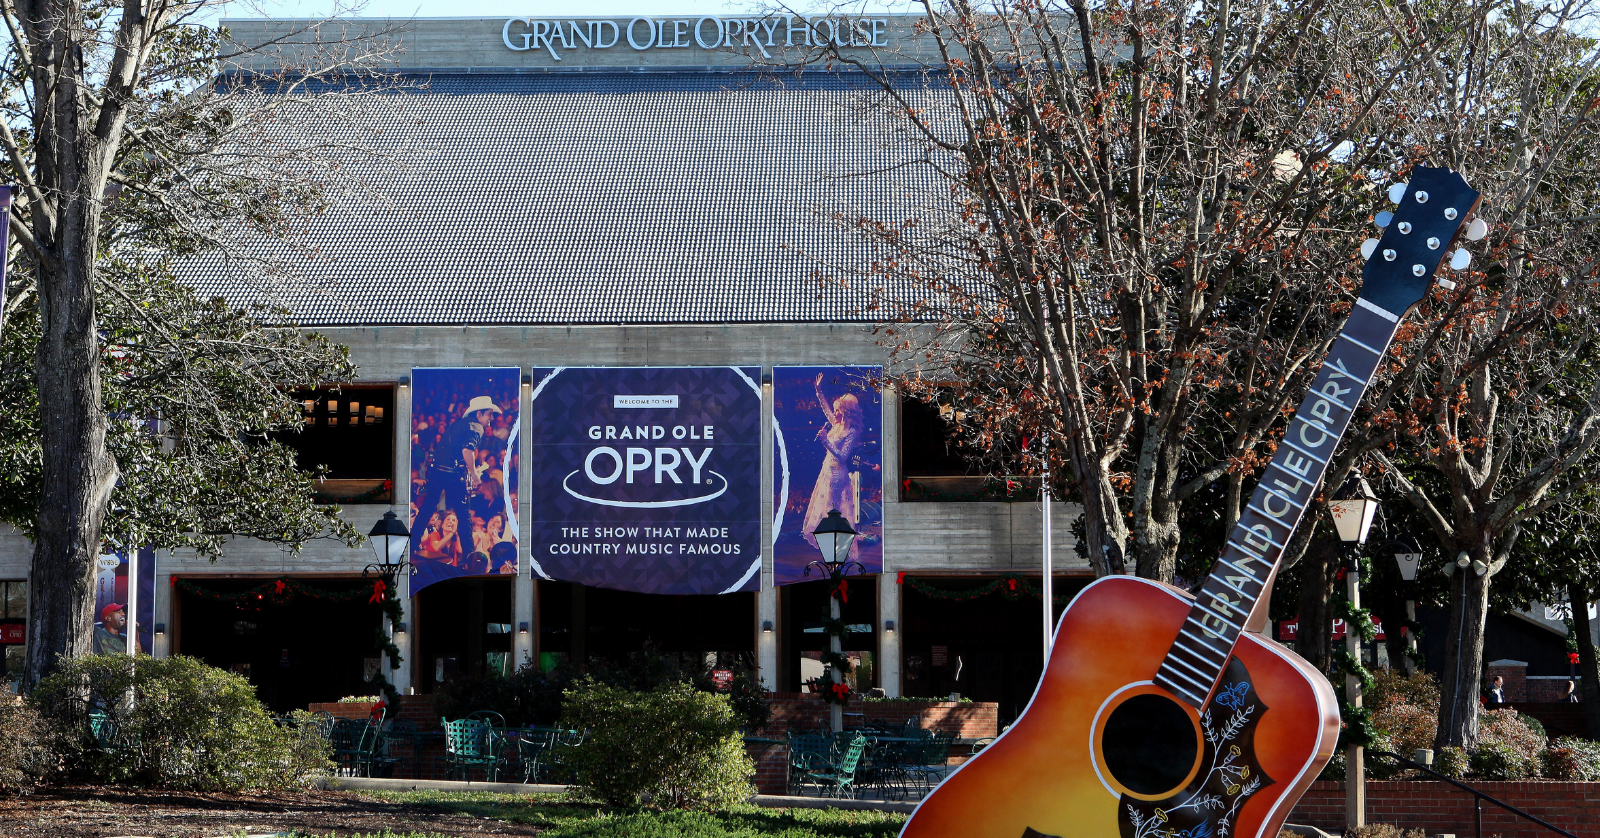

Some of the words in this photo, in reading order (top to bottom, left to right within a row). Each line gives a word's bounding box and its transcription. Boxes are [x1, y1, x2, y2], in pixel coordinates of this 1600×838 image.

[502, 16, 620, 61] GRAND
[626, 16, 690, 51] OLE
[693, 15, 779, 59] OPRY
[786, 12, 889, 48] HOUSE
[588, 425, 665, 440] GRAND
[672, 425, 714, 440] OLE
[584, 446, 714, 485] OPRY
[1201, 524, 1273, 639] GRAND
[1263, 451, 1313, 518] OLE
[1299, 357, 1352, 448] OPRY
[562, 527, 589, 538] THE
[594, 527, 639, 538] SHOW
[644, 527, 681, 538] THAT
[686, 527, 729, 538] MADE
[549, 543, 621, 554] COUNTRY
[626, 543, 673, 554] MUSIC
[679, 543, 741, 554] FAMOUS
